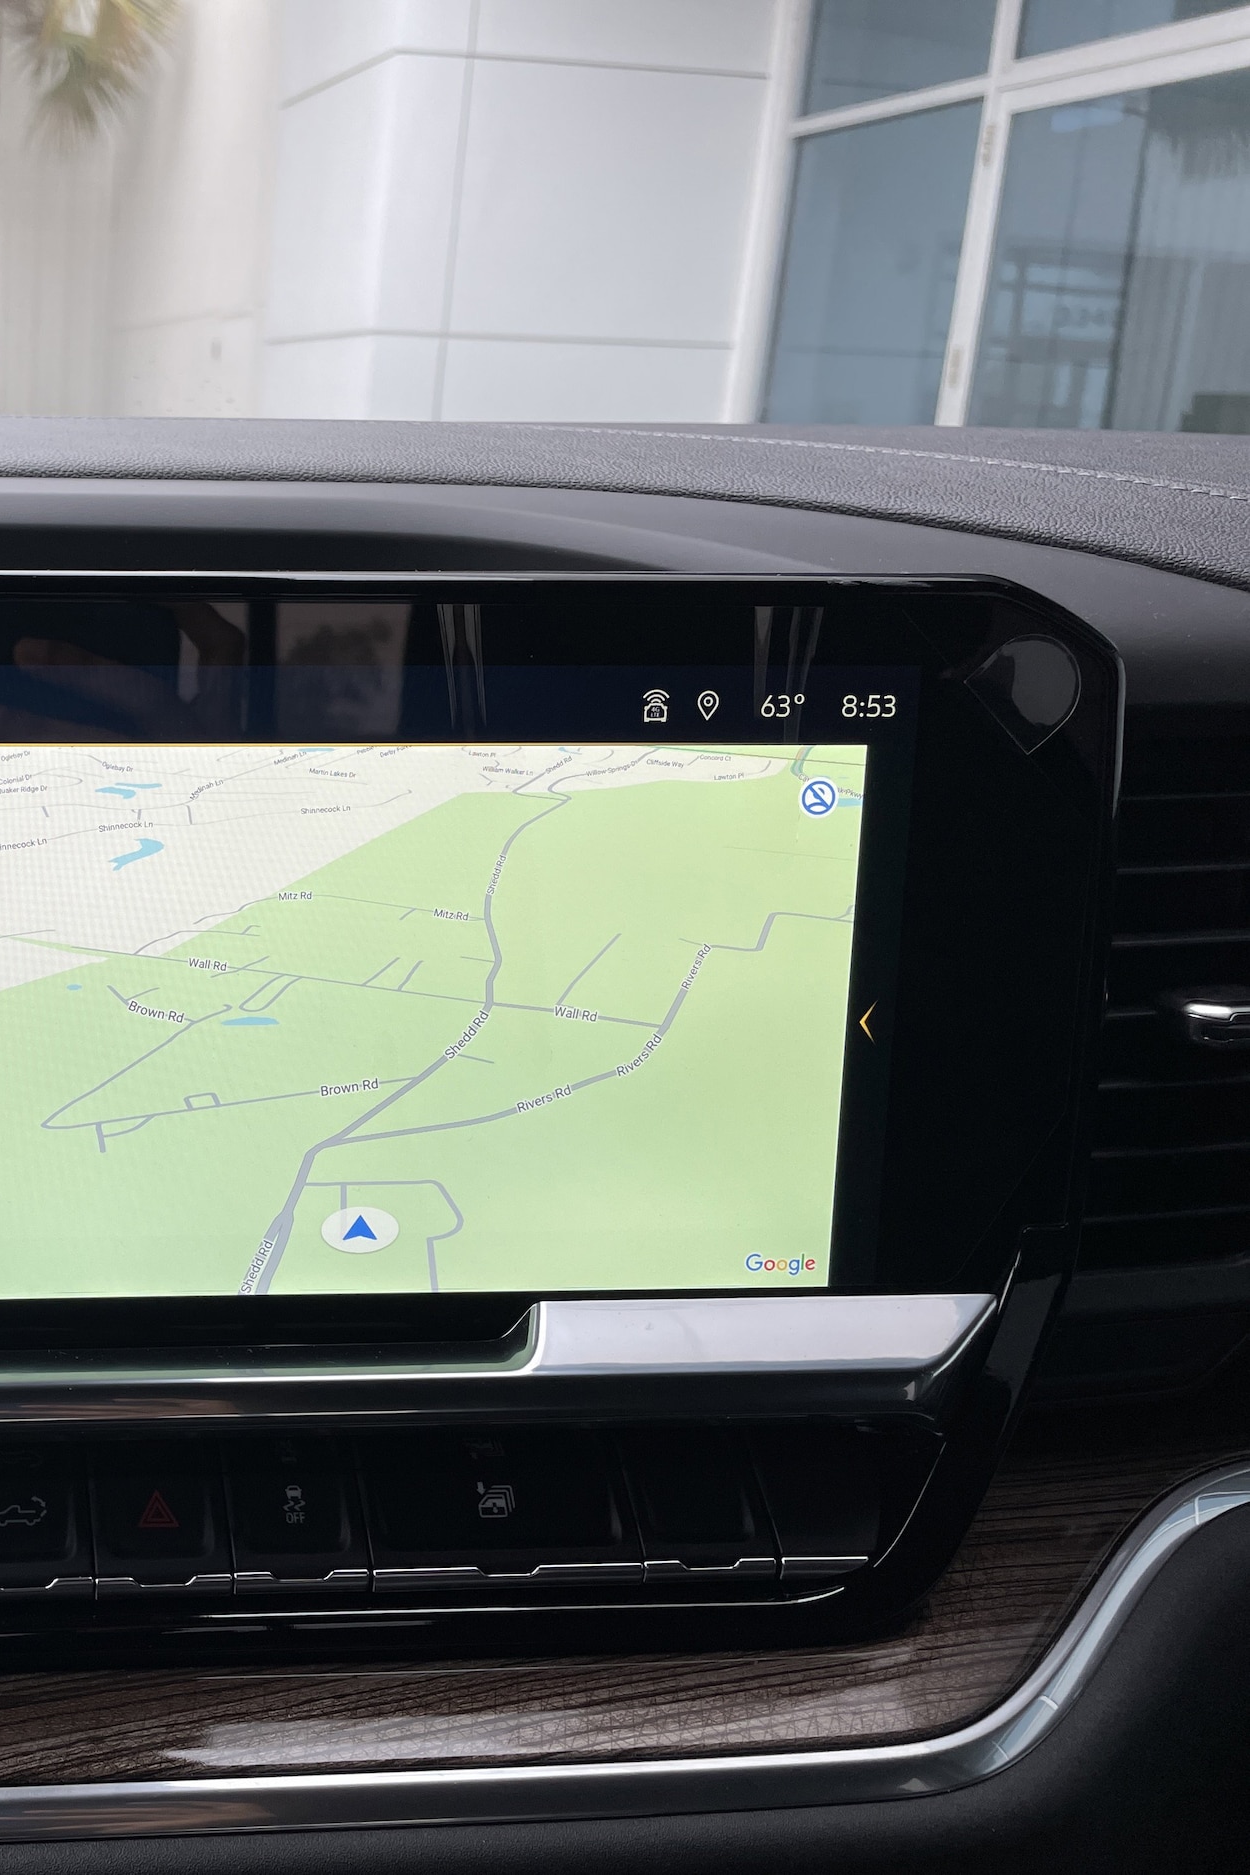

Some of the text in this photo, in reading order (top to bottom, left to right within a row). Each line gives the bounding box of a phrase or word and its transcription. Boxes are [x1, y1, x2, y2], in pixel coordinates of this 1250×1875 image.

[760, 693, 805, 718] 63°
[841, 694, 897, 718] 8:53
[273, 754, 298, 766] Medinah
[545, 755, 573, 774] Shedd Rd
[646, 758, 684, 768] Cliffside Way
[308, 767, 329, 776] Martin
[330, 769, 347, 778] Lakes
[482, 765, 504, 773] William
[504, 767, 524, 775] Walker
[586, 769, 607, 777] Willow
[607, 763, 631, 775] Springs
[20, 785, 39, 794] Ridge
[190, 778, 224, 801] Medinah Ln
[300, 805, 341, 814] Shinnecock
[98, 820, 153, 833] Shinnecock Ln
[37, 838, 48, 846] Ln
[486, 854, 507, 896] Shedd Rd
[278, 891, 312, 901] Mitz Rd
[433, 908, 469, 921] Mitz Rd
[188, 957, 227, 972] Wall Rd
[681, 943, 712, 991] Rivers Rd
[127, 1000, 184, 1024] Brown Rd
[554, 1006, 598, 1023] Wall Rd
[444, 1010, 490, 1061] Shedd Rd
[616, 1033, 663, 1078] Rivers Rd
[319, 1078, 379, 1097] Brown Rd
[516, 1084, 573, 1114] Rivers Rd
[240, 1239, 274, 1294] Shedd Rd
[745, 1253, 816, 1276] Google
[285, 1511, 306, 1524] OFF
